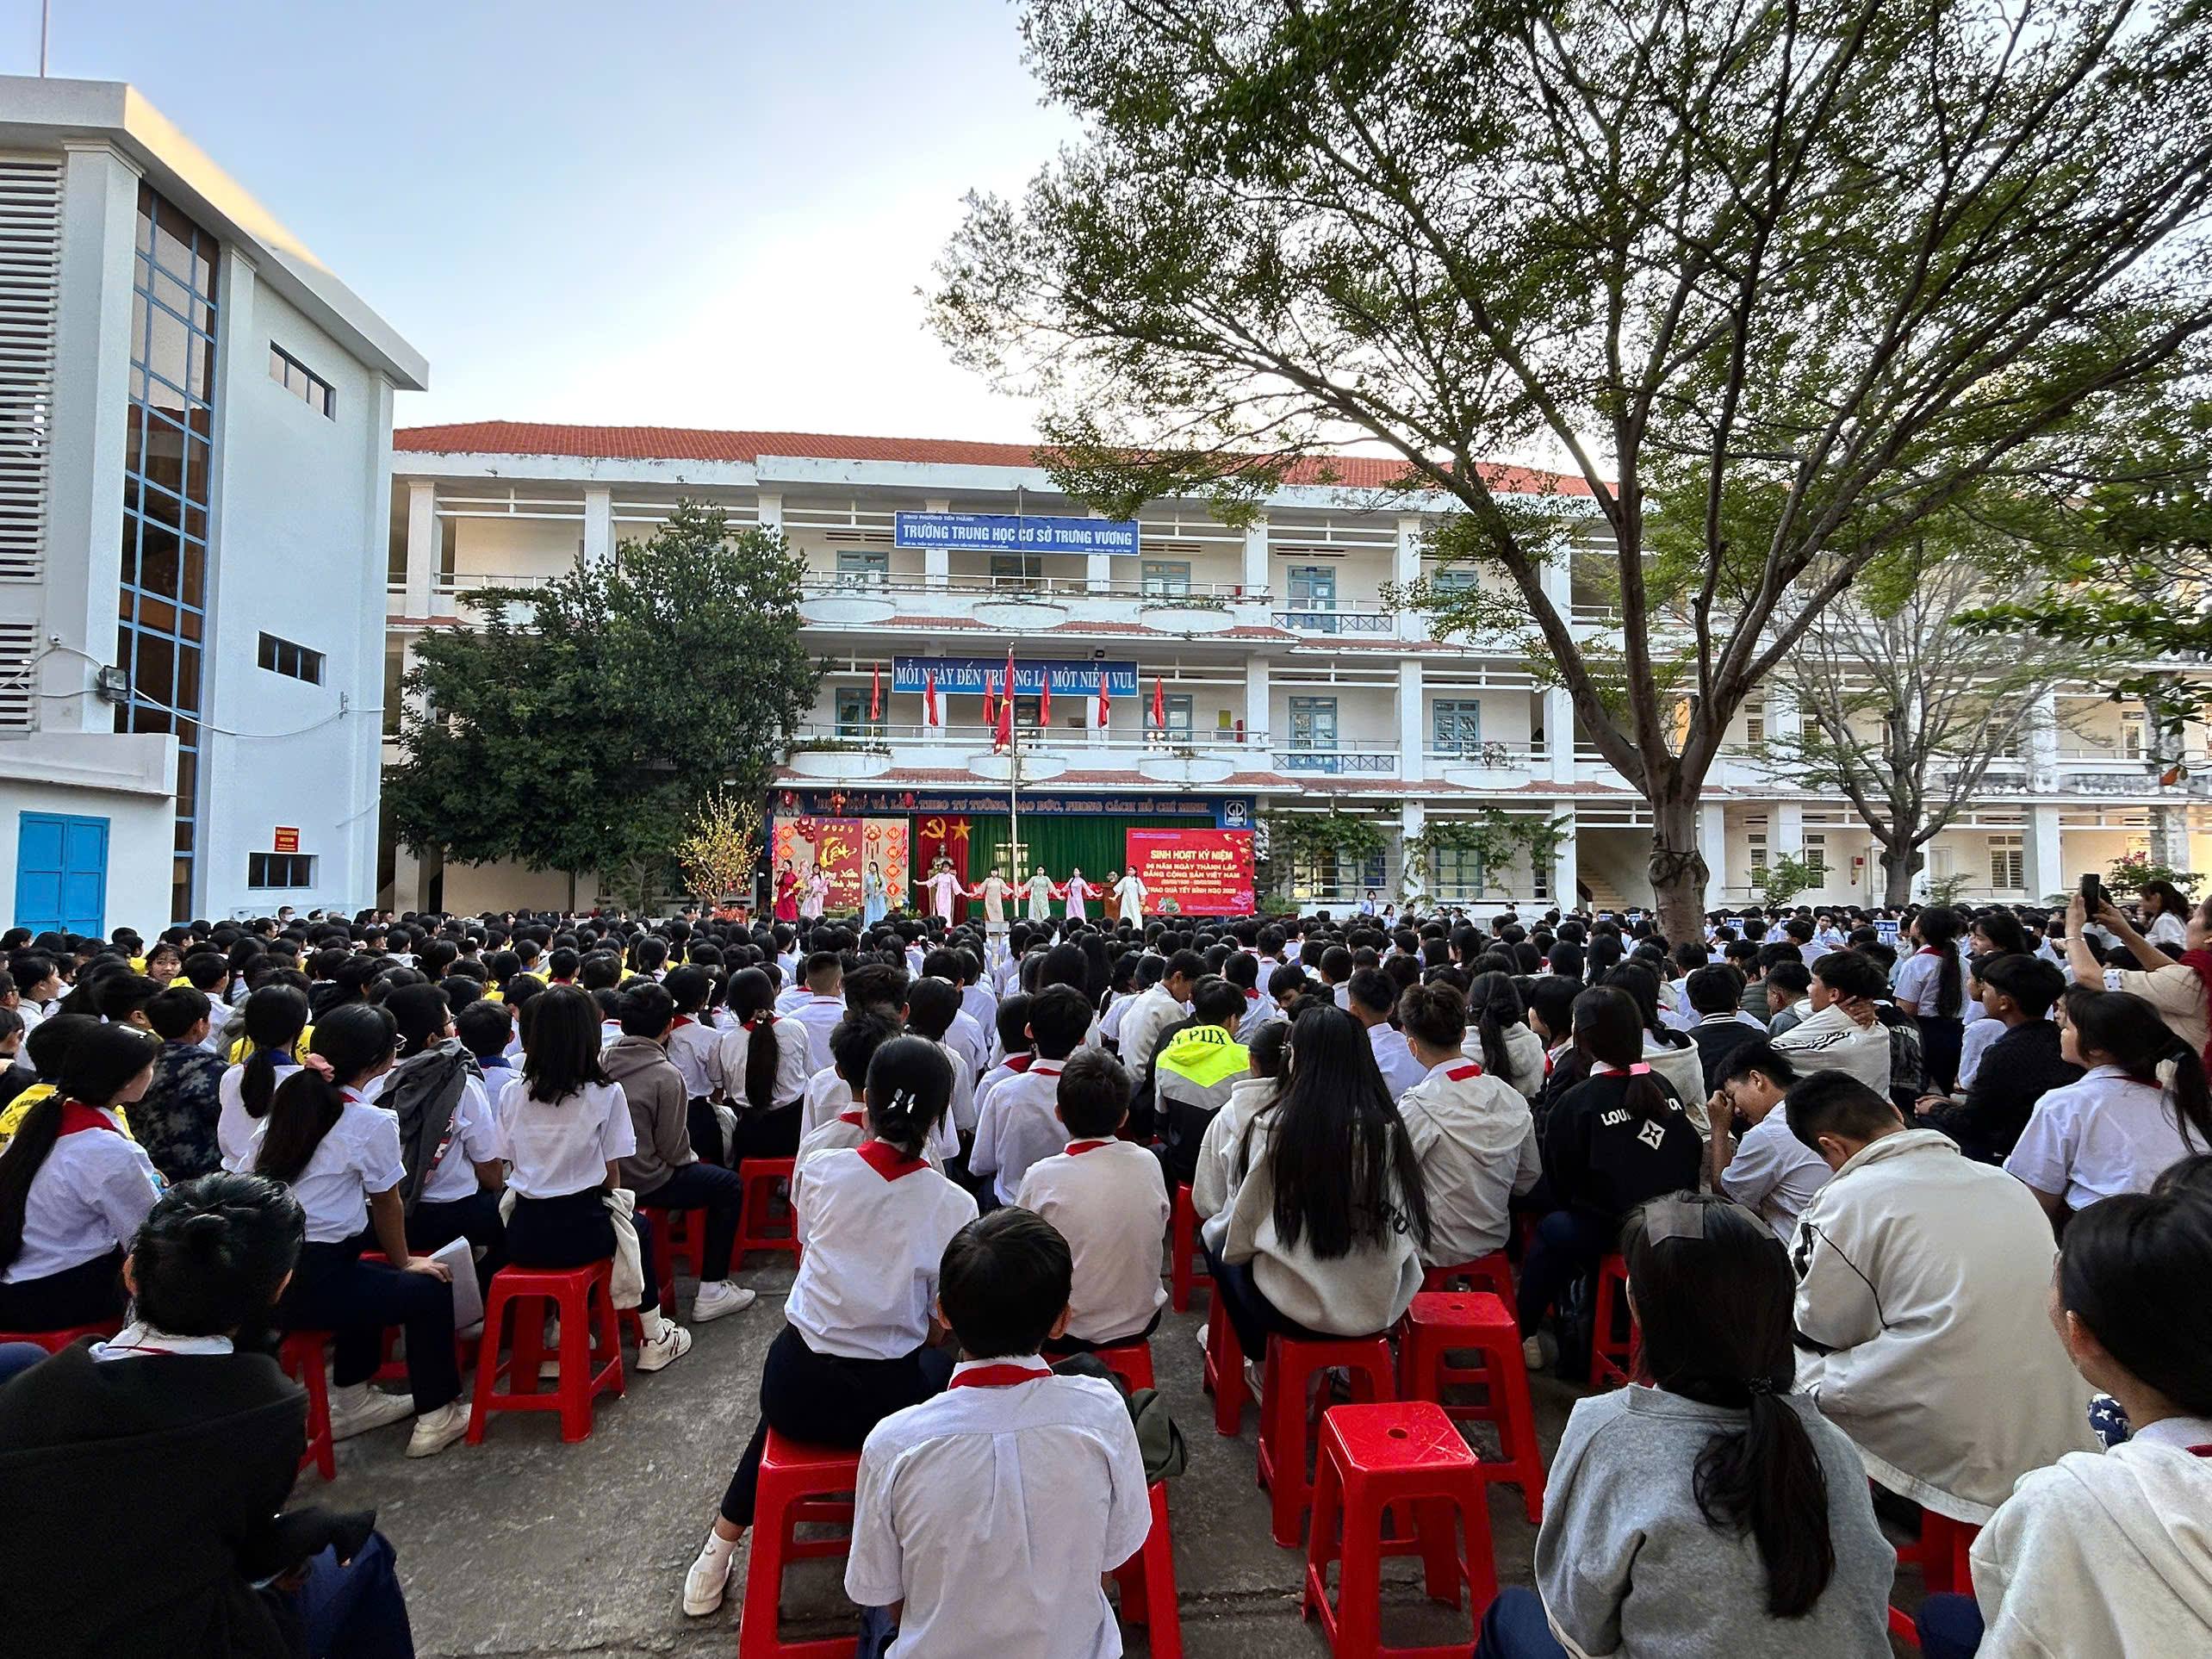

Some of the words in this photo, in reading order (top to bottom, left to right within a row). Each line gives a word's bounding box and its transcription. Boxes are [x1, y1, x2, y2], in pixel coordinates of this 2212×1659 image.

[903, 522, 948, 539] TRƯỜNG
[952, 526, 990, 541] TRUNG
[992, 527, 1016, 544] HỌC
[1018, 527, 1034, 542] CƠ
[1036, 525, 1053, 543] SỞ
[1055, 529, 1092, 544] TRƯNG
[1095, 531, 1133, 545] VƯƠNG
[896, 659, 919, 684] MỖI
[922, 663, 954, 685] NGÀY
[957, 661, 981, 686] ĐẾN
[1052, 667, 1078, 692] MỘT
[1066, 800, 1103, 811] PHONG
[1105, 798, 1135, 812] CÁCH
[1138, 798, 1154, 812] HỒ
[1157, 799, 1176, 812] CHÍ
[1150, 849, 1171, 860] SINH
[1173, 850, 1196, 861] HOẠT
[1212, 849, 1233, 861] NIỆM
[1206, 871, 1222, 879] VIỆT
